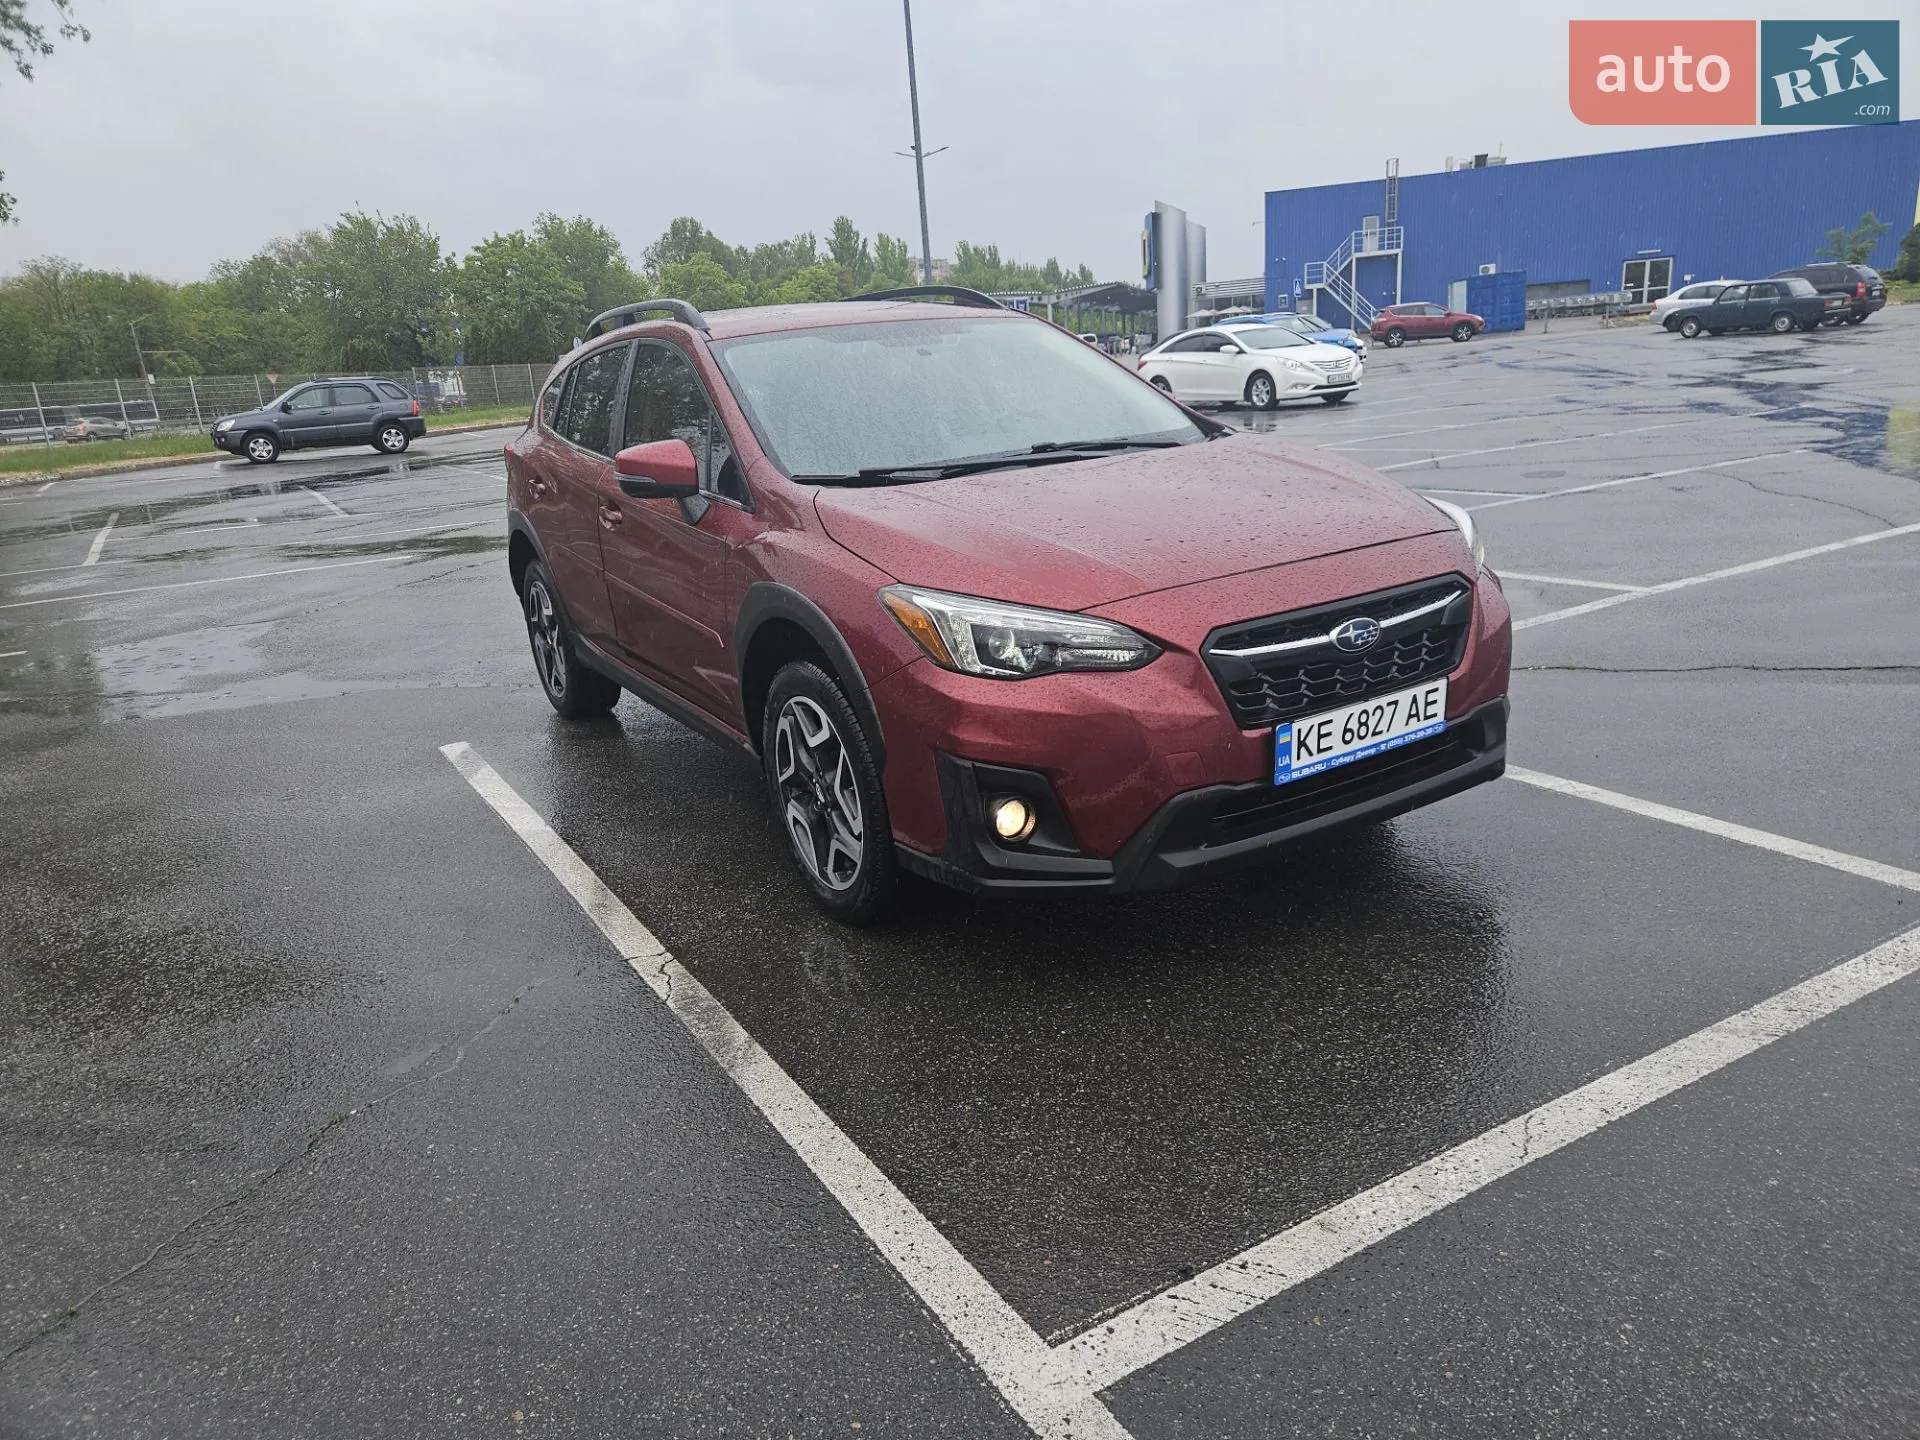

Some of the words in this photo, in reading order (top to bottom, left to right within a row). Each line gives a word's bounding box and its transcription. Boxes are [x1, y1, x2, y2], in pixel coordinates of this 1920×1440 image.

[1296, 718, 1334, 761] KE
[1341, 700, 1400, 746] 6827
[1405, 687, 1439, 727] AE
[1278, 755, 1290, 767] UA
[1291, 762, 1327, 779] SUBARU
